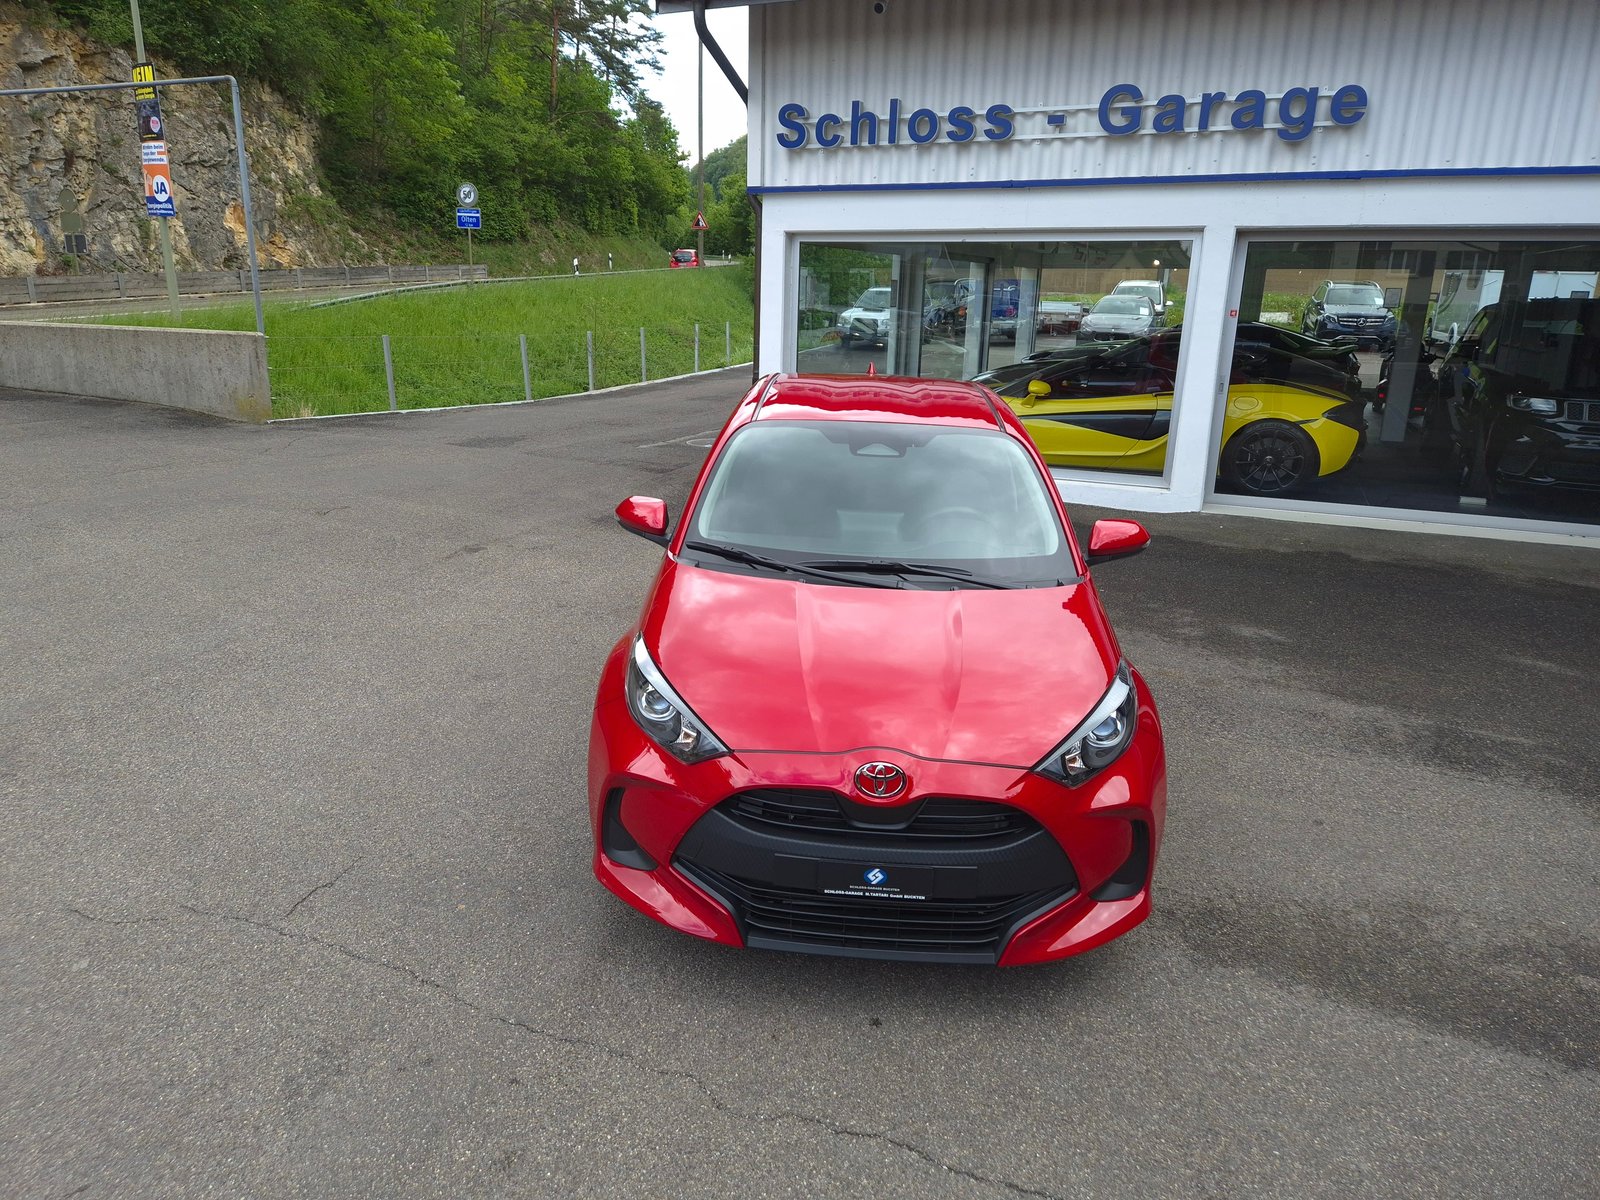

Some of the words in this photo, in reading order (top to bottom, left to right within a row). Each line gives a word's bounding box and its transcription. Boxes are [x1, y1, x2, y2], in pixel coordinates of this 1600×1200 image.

[777, 98, 1015, 149] Schloss
[1046, 114, 1068, 126] -
[1098, 83, 1369, 142] Garage
[154, 182, 168, 194] JA
[463, 190, 472, 200] 50
